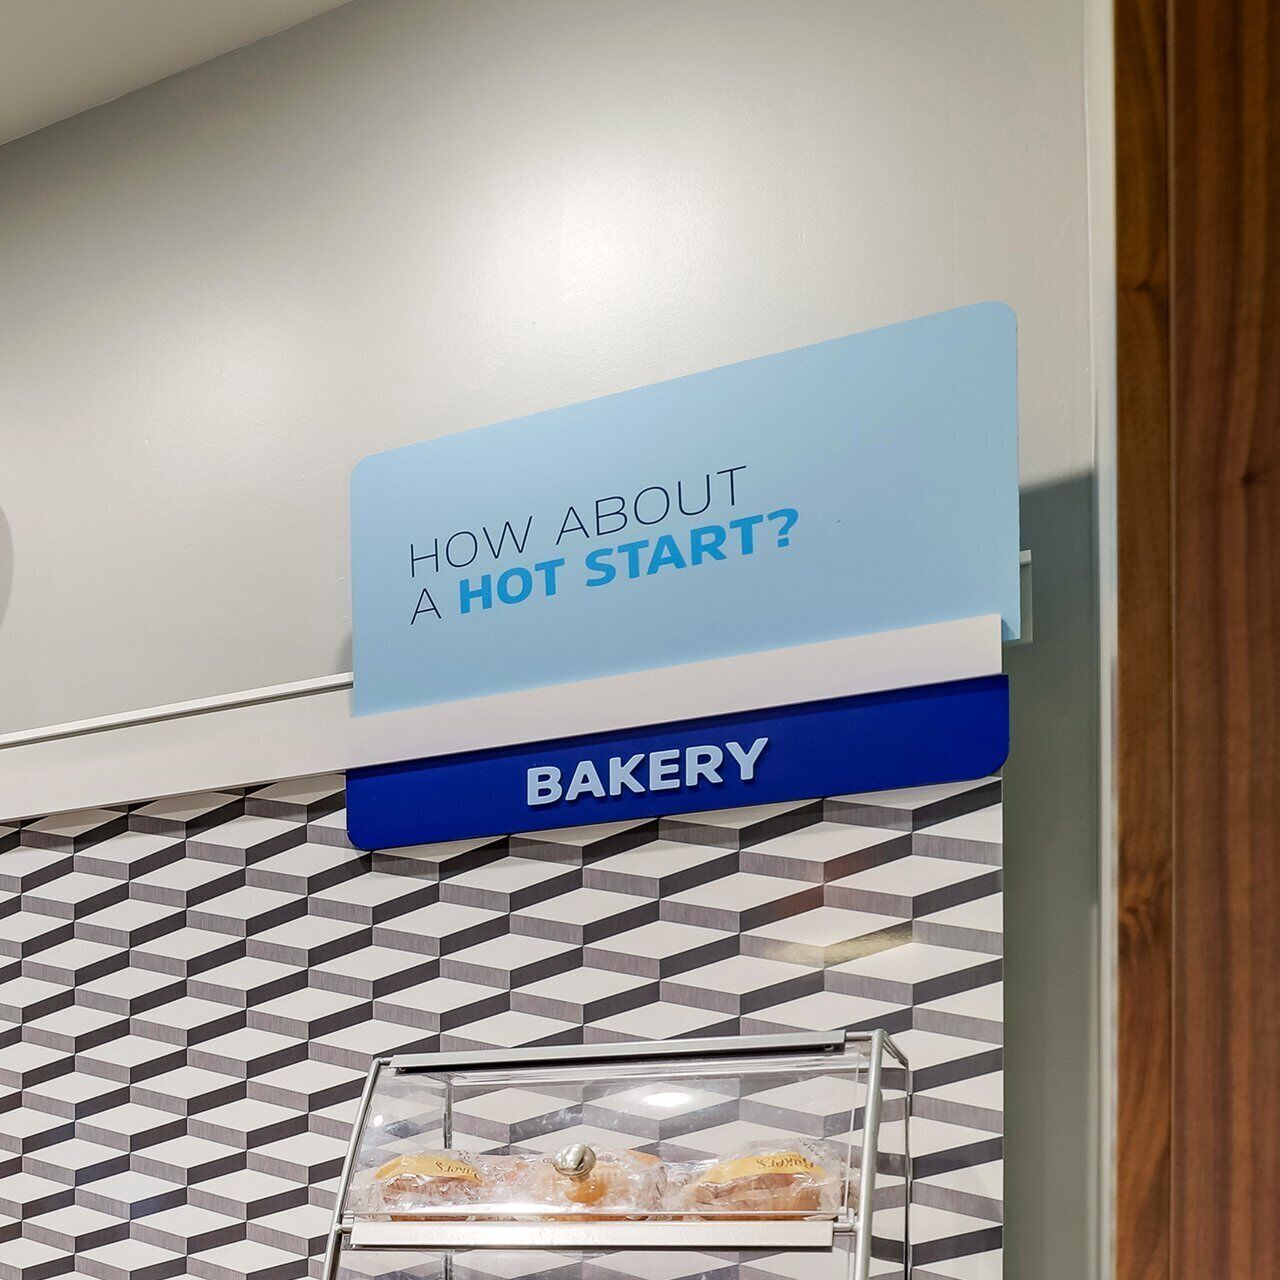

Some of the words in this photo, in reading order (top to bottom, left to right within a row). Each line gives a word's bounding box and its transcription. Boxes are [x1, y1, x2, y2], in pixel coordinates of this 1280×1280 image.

[410, 515, 533, 578] HOW
[555, 465, 747, 546] ABOUT
[410, 588, 442, 626] A
[459, 557, 566, 615] HOT
[585, 507, 800, 588] START?
[526, 737, 770, 807] BAKERY
